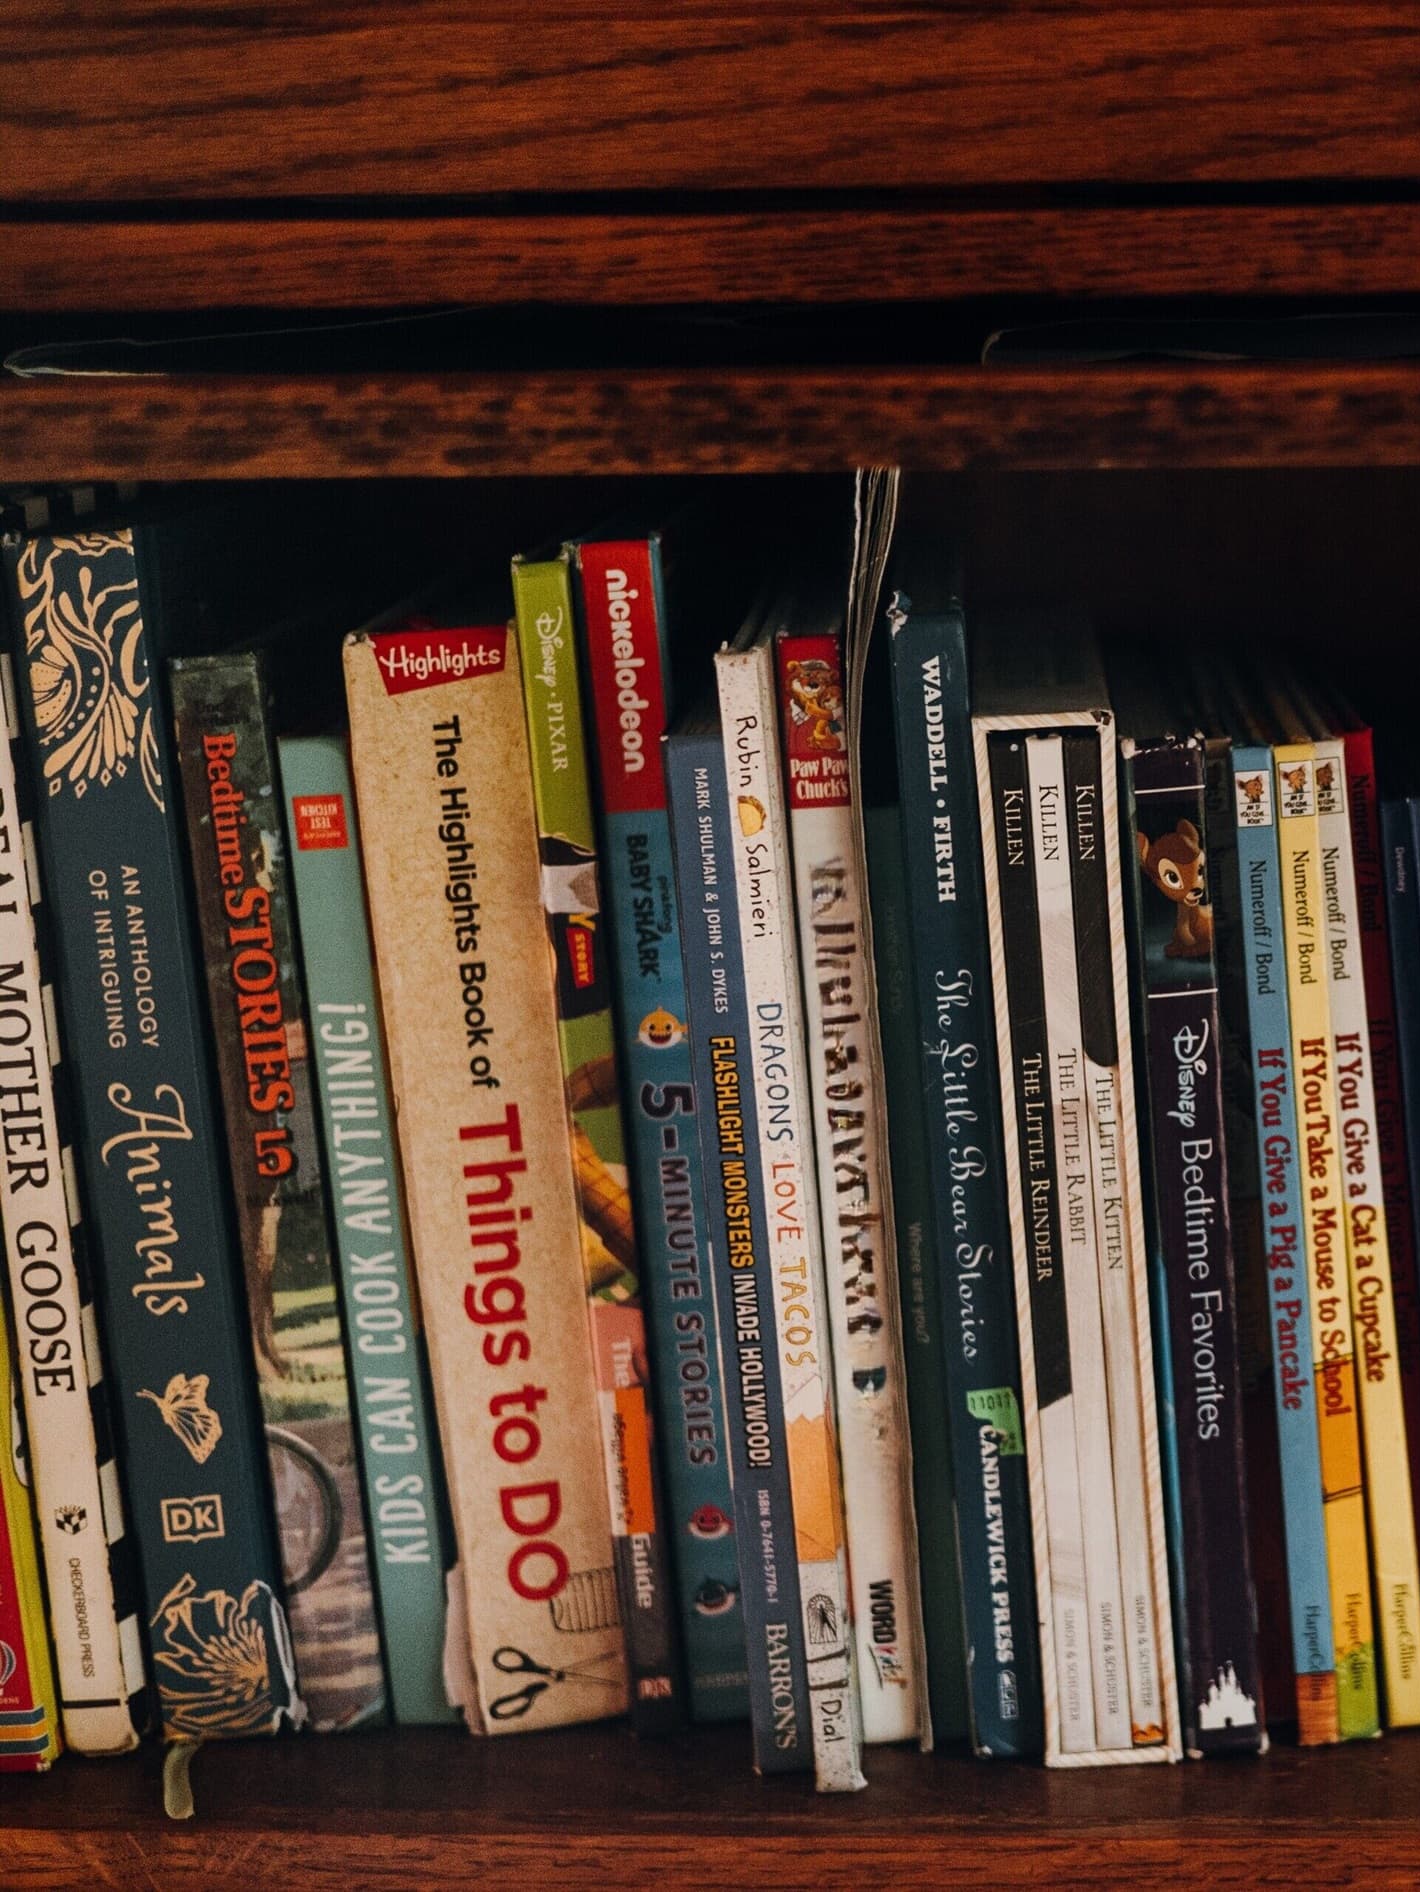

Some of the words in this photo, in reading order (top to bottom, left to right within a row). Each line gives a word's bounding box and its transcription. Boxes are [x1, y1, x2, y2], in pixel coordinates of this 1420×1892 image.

[379, 640, 501, 681] Highlights
[605, 569, 650, 773] nickelodeon
[432, 715, 460, 777] The
[546, 702, 568, 772] PIXAR
[736, 715, 759, 788] Rubin
[921, 656, 948, 792] WADDELL
[203, 732, 244, 885] Bedtime
[310, 817, 331, 830] TEST
[694, 767, 710, 810] MARK
[1003, 788, 1024, 866] KILLEN
[1039, 784, 1059, 861] KILLEN
[1075, 784, 1095, 861] KILLEN
[88, 870, 107, 900] OF
[121, 865, 138, 894] AN
[439, 786, 481, 953] Highlights
[698, 815, 718, 887] SHULMAN
[744, 843, 777, 938] Salmieri
[932, 816, 956, 903] FIRTH
[1292, 850, 1314, 928] Numeroff
[1322, 847, 1346, 925] Numeroff
[1249, 860, 1272, 938] Numeroff
[95, 911, 126, 1049] INTRIGUING
[124, 904, 159, 1048] ANTHOLOGY
[711, 968, 728, 1014] DYKES
[936, 968, 974, 1031] The
[1330, 939, 1350, 981] Bond
[225, 887, 295, 1115] STORIES
[459, 961, 494, 1049] Book
[0, 962, 49, 1193] MOTHER
[469, 1055, 499, 1089] of
[709, 1035, 738, 1156] FLASHLIGHT
[756, 1002, 794, 1143] DRAGONS
[940, 1038, 979, 1143] Little
[1057, 1048, 1077, 1093] THE
[1095, 1072, 1114, 1117] THE
[1259, 1073, 1287, 1128] You
[1301, 1060, 1327, 1114] You
[1338, 1055, 1363, 1110] You
[254, 1129, 293, 1177] 5
[318, 1003, 392, 1234] ANYTHING!
[1024, 1101, 1051, 1172] LITTLE
[1060, 1096, 1081, 1167] LITTLE
[1097, 1120, 1117, 1189] LITTLE
[1306, 1115, 1333, 1178] Take
[1342, 1117, 1368, 1176] Give
[101, 1082, 205, 1316] Animals
[771, 1162, 801, 1243] LOVE
[949, 1146, 987, 1235] Bear
[1263, 1135, 1291, 1194] Give
[459, 1104, 533, 1370] Things
[720, 1158, 756, 1269] MONSTERS
[1031, 1179, 1053, 1282] REINDEER
[1066, 1173, 1087, 1245] RABBIT
[1103, 1196, 1123, 1270] KITTEN
[1180, 1138, 1216, 1280] Bedtime
[1267, 1223, 1297, 1271] Pig
[1312, 1206, 1336, 1290] Mouse
[1350, 1204, 1376, 1247] Cat
[16, 1221, 76, 1396] GOOSE
[351, 1251, 406, 1354] COOK
[641, 1082, 699, 1299] 5-MINUTE
[675, 1312, 718, 1467] STORIES
[733, 1272, 760, 1343] INVADE
[779, 1257, 818, 1367] TACOS
[956, 1242, 995, 1364] Stories
[1190, 1289, 1224, 1441] Favorites
[1275, 1298, 1301, 1410] Pancake
[1356, 1276, 1391, 1383] Cupcake
[738, 1347, 772, 1470] HOLLYWOOD!
[1319, 1329, 1352, 1418] School
[364, 1377, 418, 1454] CAN
[489, 1384, 548, 1466] to
[171, 1508, 216, 1531] DK
[376, 1475, 430, 1563] KIDS
[500, 1480, 570, 1602] DO
[979, 1424, 1009, 1587] CANDLEWICK
[68, 1557, 90, 1640] CHECKERBOARD
[81, 1642, 95, 1677] PRESS
[766, 1622, 796, 1750] BARRON'S
